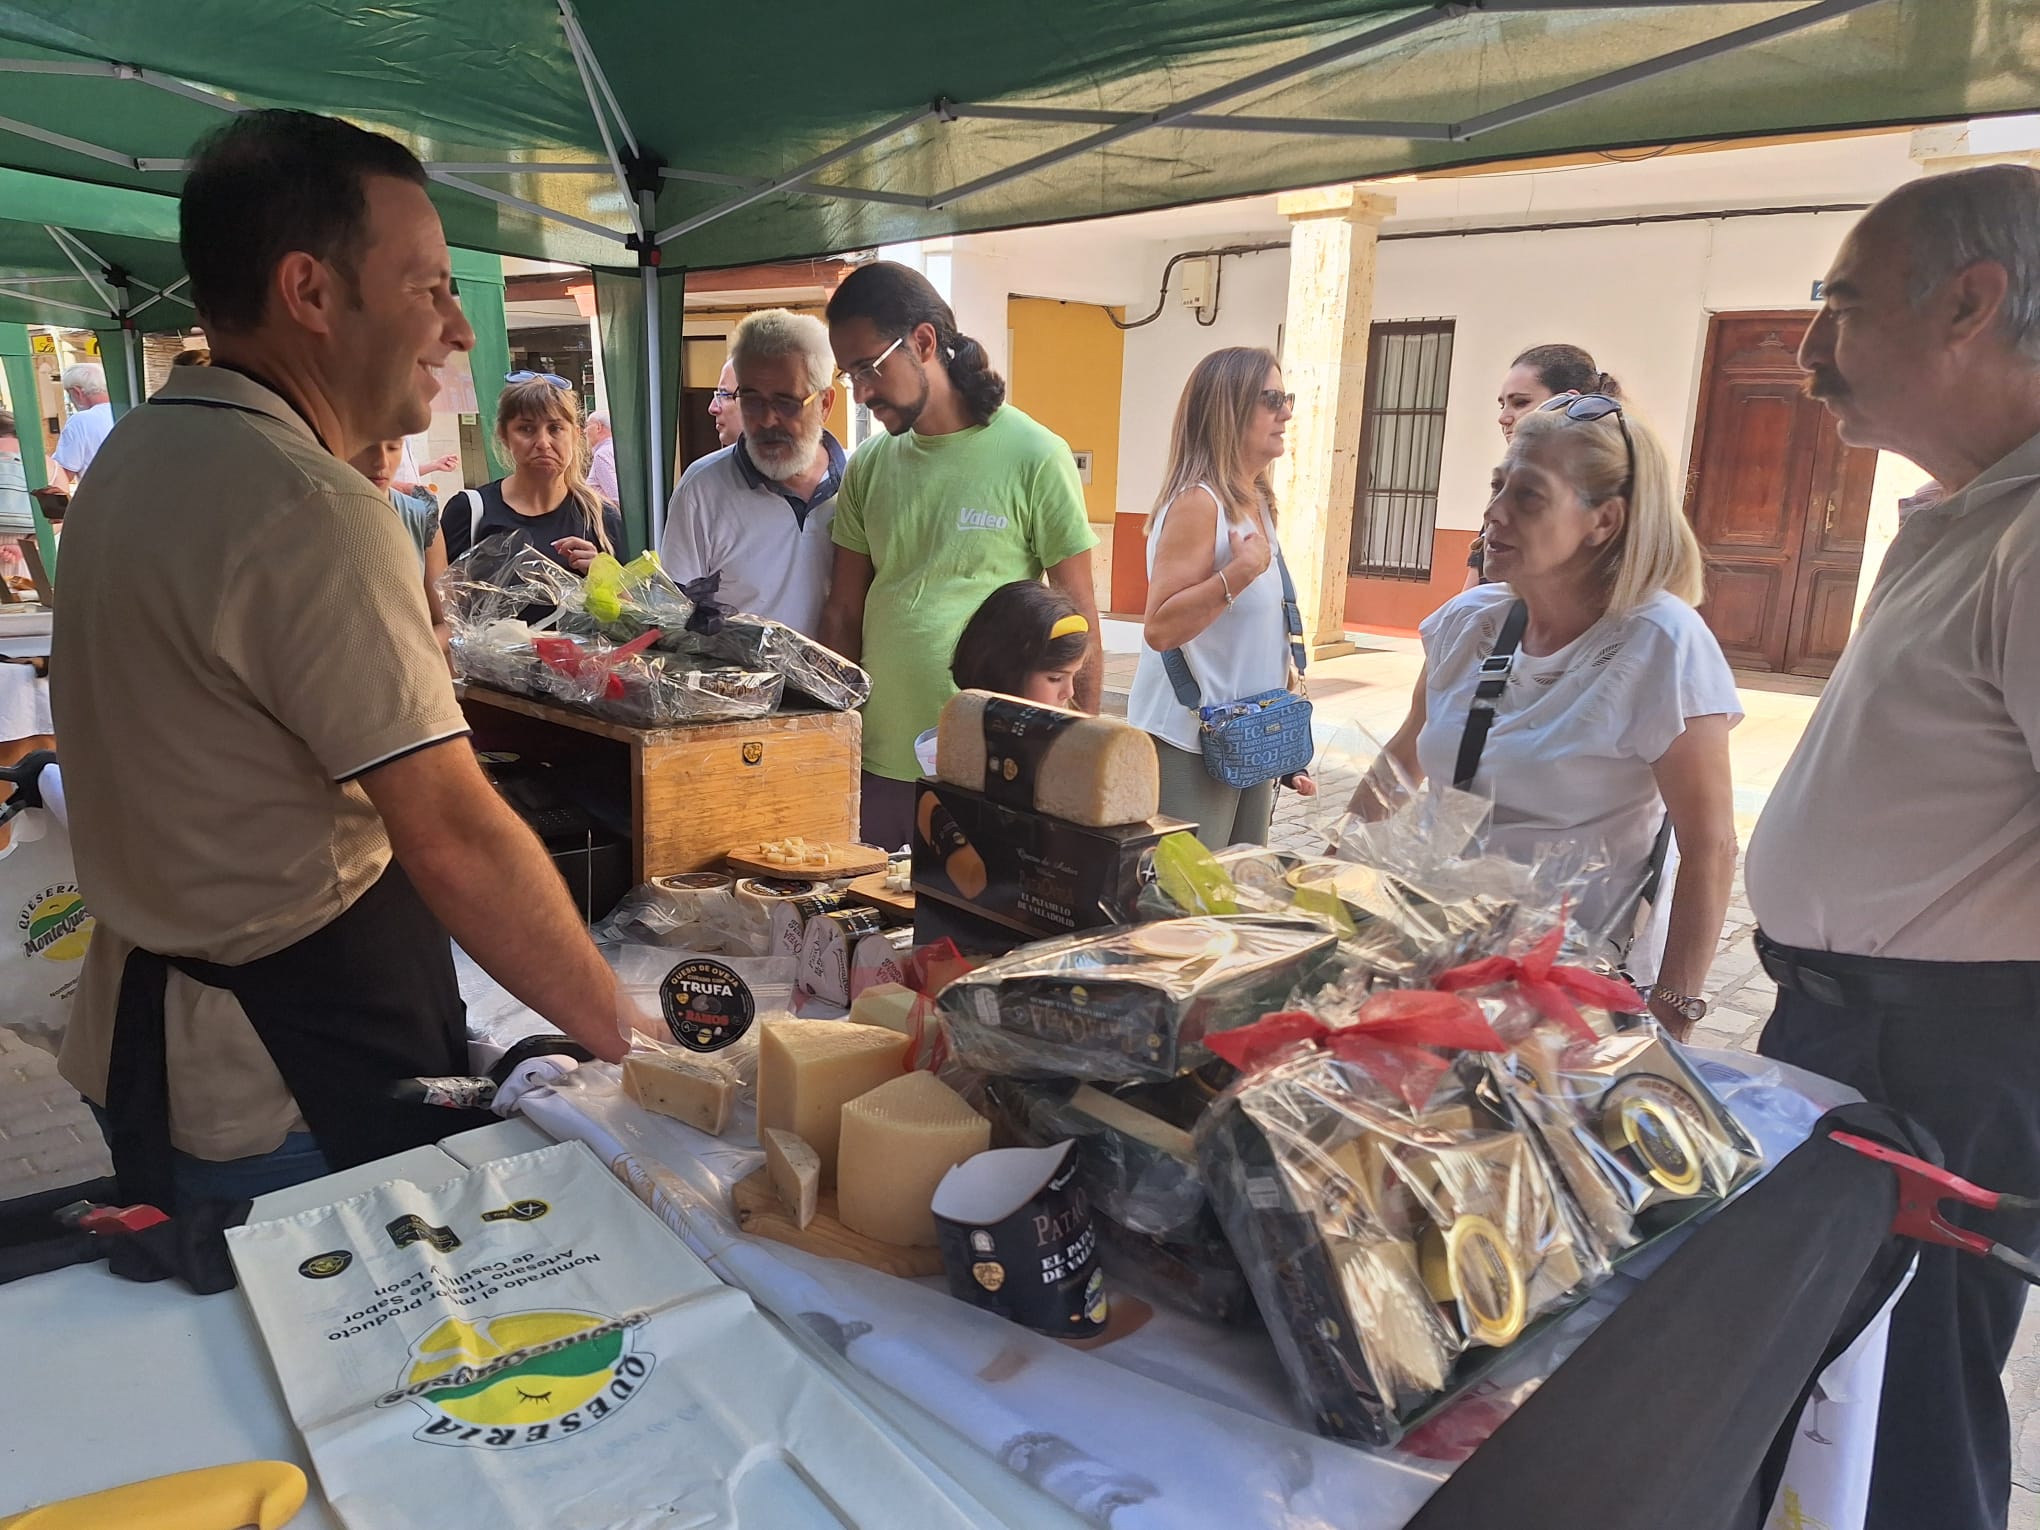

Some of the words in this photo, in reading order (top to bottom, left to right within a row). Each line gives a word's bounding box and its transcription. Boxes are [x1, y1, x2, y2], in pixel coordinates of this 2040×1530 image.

[960, 507, 1008, 529] Valeo
[19, 884, 80, 930] QUESERI
[1017, 900, 1028, 911] DE
[1029, 904, 1075, 928] VALLADOLID
[671, 965, 697, 985] QUESO
[711, 967, 739, 988] OVEJA
[680, 981, 733, 997] TRUFA
[491, 1249, 573, 1280] Artesano
[511, 1253, 534, 1264] de
[1041, 1253, 1065, 1270] EL
[504, 1253, 601, 1289] Nombrado
[1042, 1265, 1067, 1284] DE
[373, 1271, 424, 1296] León
[410, 1280, 433, 1296] de
[481, 1286, 499, 1299] el
[328, 1298, 423, 1341] producto
[343, 1295, 405, 1324] Sabor
[424, 1354, 646, 1446] QUESERIA
